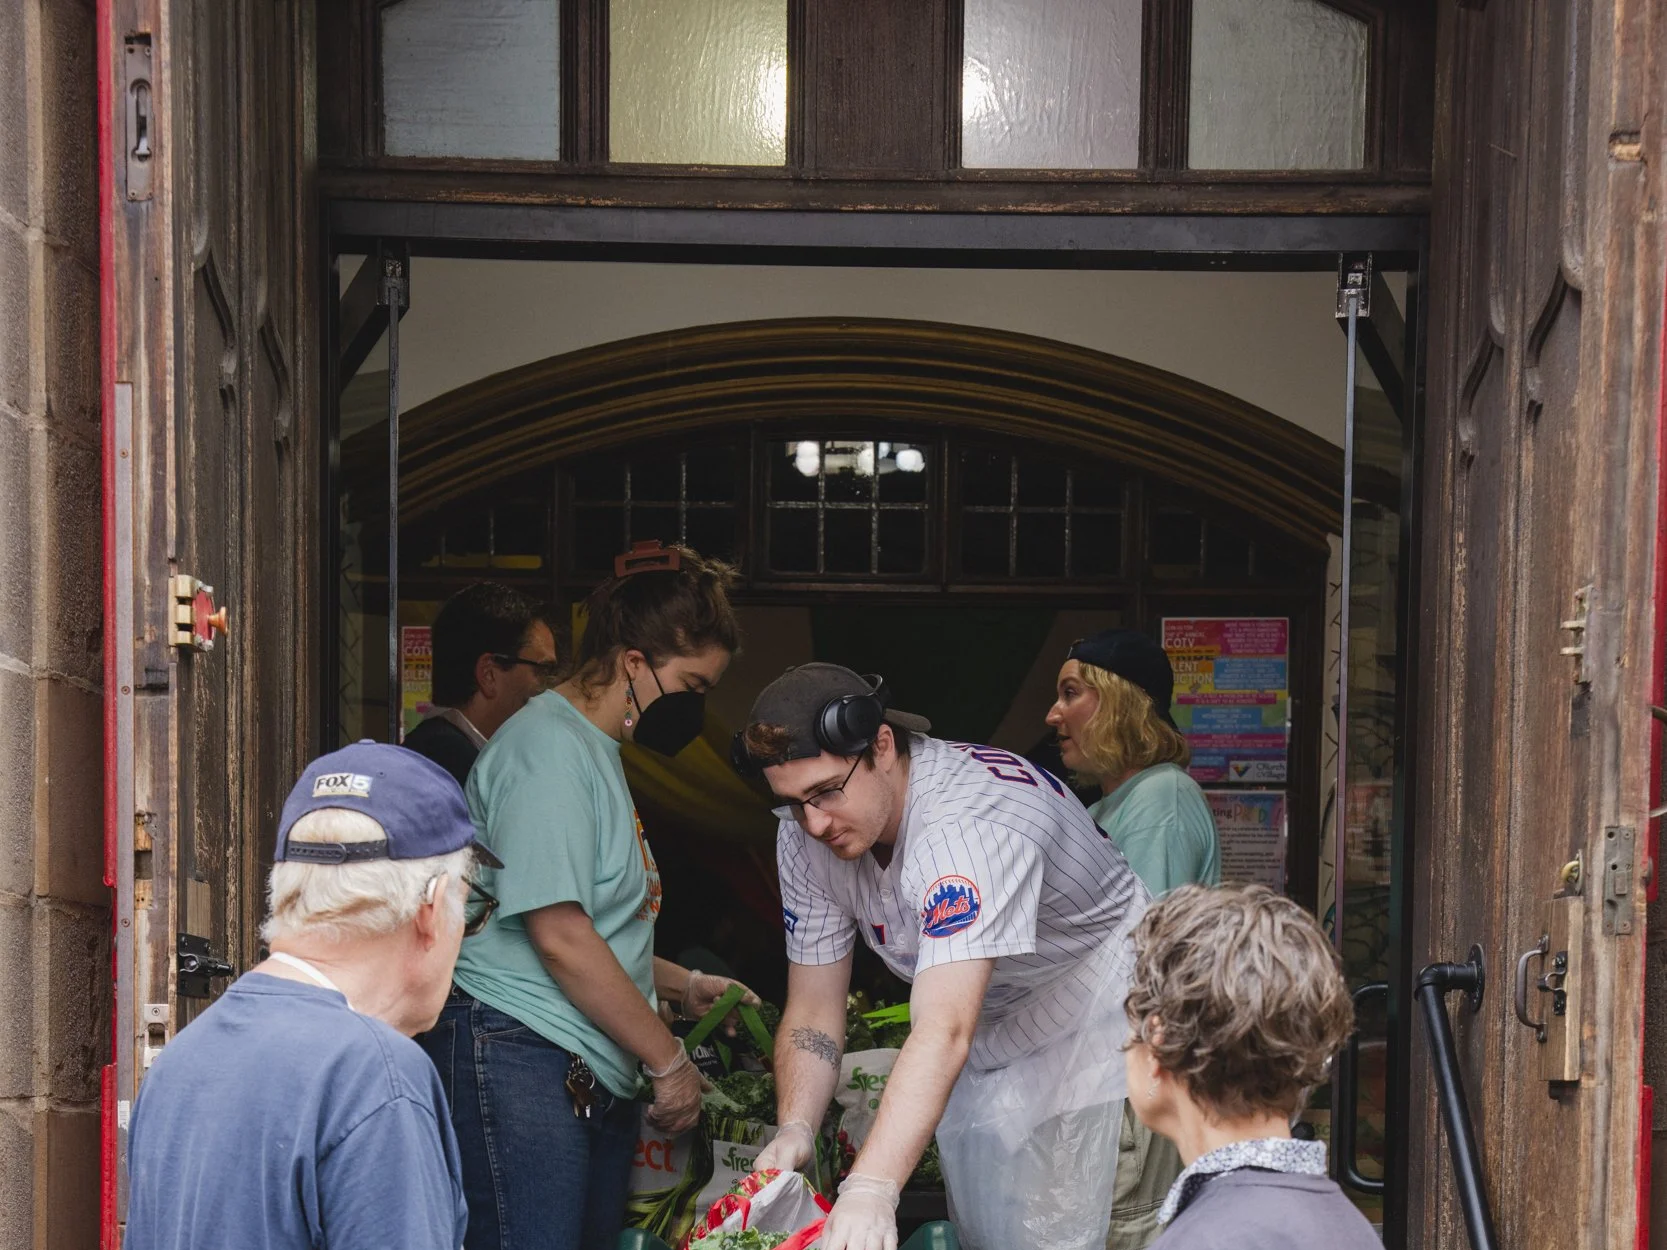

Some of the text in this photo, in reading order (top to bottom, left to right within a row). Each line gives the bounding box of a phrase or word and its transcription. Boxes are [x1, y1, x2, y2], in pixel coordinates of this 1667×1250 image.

[1165, 637, 1195, 648] COTV
[404, 669, 432, 681] SILEN
[1173, 672, 1214, 683] UCTION
[316, 774, 370, 791] FOX 5
[1213, 808, 1232, 819] ting
[927, 895, 970, 928] Mets
[852, 1066, 888, 1092] fres
[631, 1139, 674, 1172] ect
